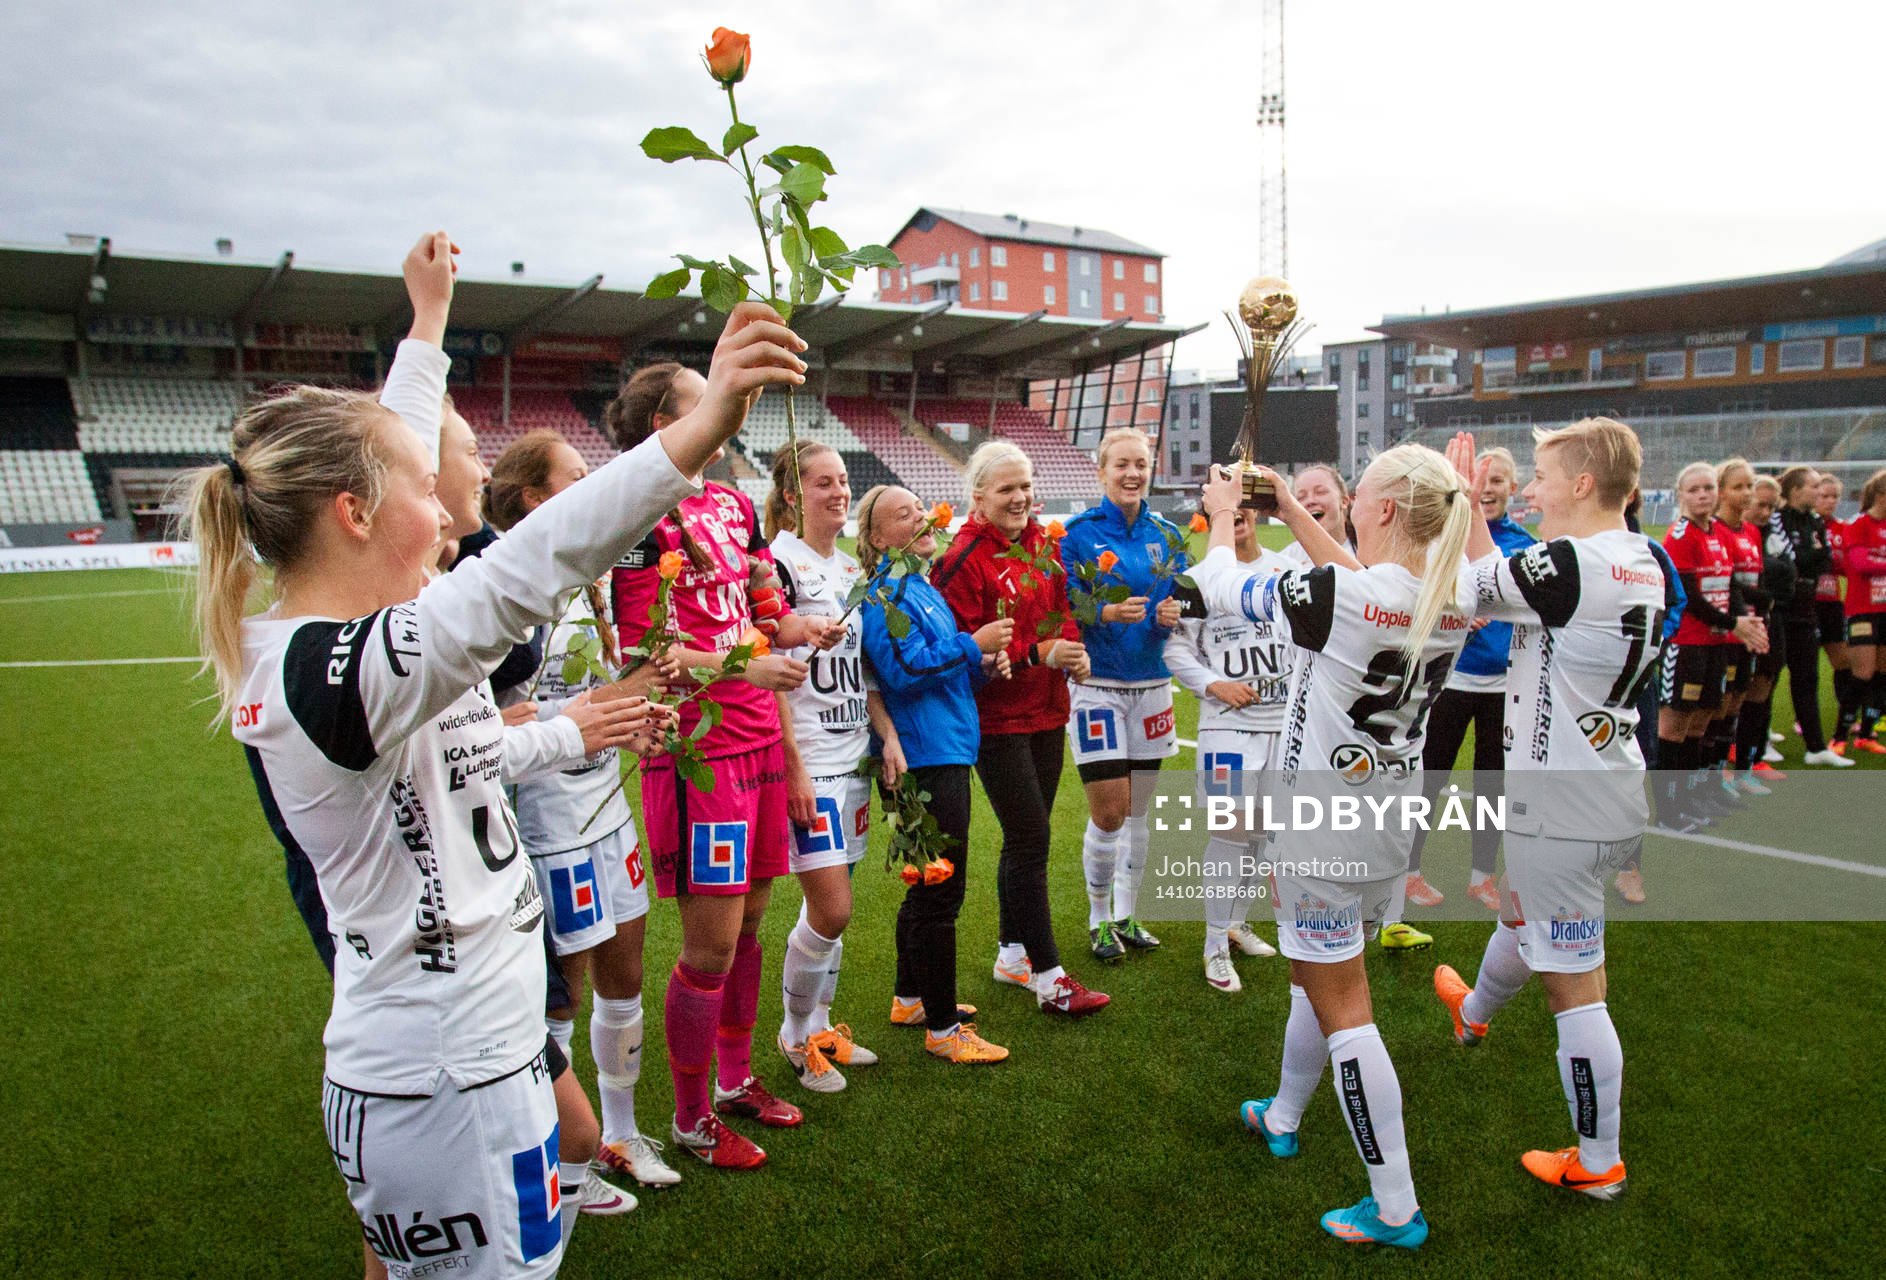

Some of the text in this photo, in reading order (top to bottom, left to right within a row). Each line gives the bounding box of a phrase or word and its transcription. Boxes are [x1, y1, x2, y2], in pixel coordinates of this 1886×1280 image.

[1363, 603, 1413, 630] Uppla
[1346, 649, 1456, 747] 21
[235, 702, 263, 728] or
[443, 746, 469, 764] ICA
[1576, 1087, 1593, 1136] Lundqvist
[1350, 1095, 1377, 1160] Lundqvist
[412, 1255, 470, 1278] EFFEKT
